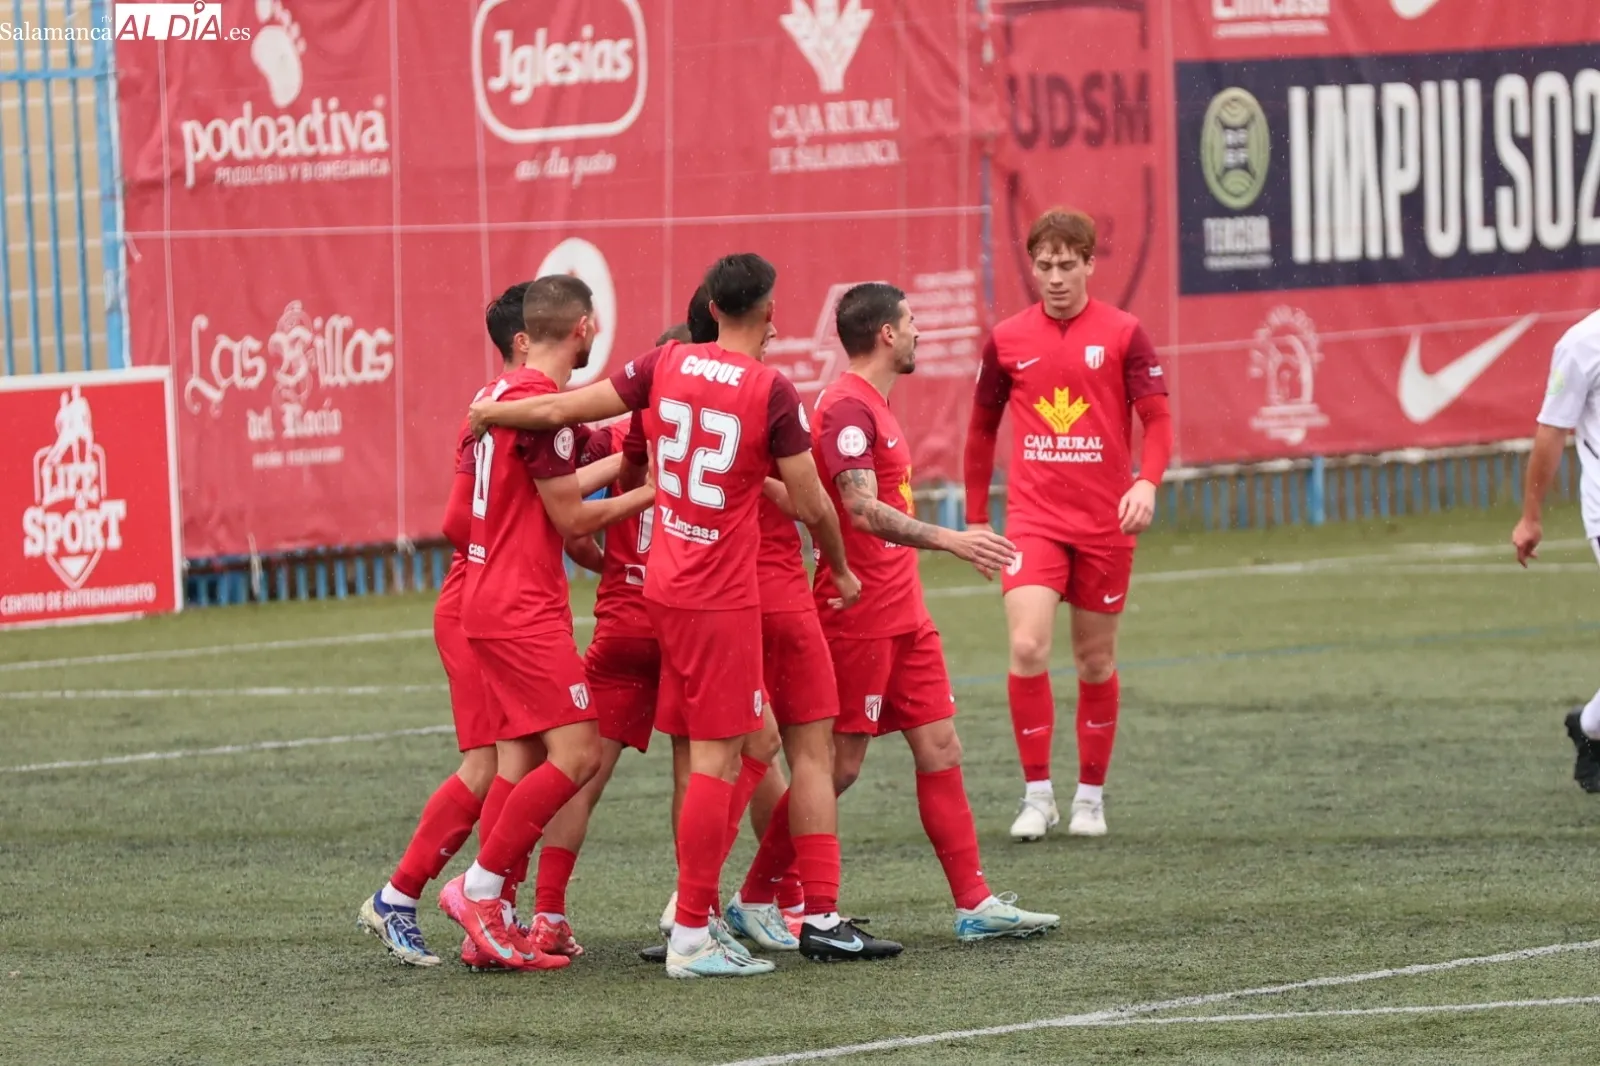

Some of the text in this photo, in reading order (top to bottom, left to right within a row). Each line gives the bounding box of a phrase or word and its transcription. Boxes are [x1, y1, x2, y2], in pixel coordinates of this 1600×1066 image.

[770, 102, 826, 145] CAJA
[1005, 69, 1154, 150] UDSM
[182, 97, 390, 190] podoactiva
[184, 314, 267, 419] Las
[680, 354, 746, 387] COQUE
[658, 397, 742, 510] 22
[1023, 449, 1104, 463] DE SALAMANCA
[1024, 434, 1104, 452] CAJA RURAL
[22, 499, 127, 557] SPORT
[0, 592, 46, 616] CENTRO
[46, 590, 62, 612] DE
